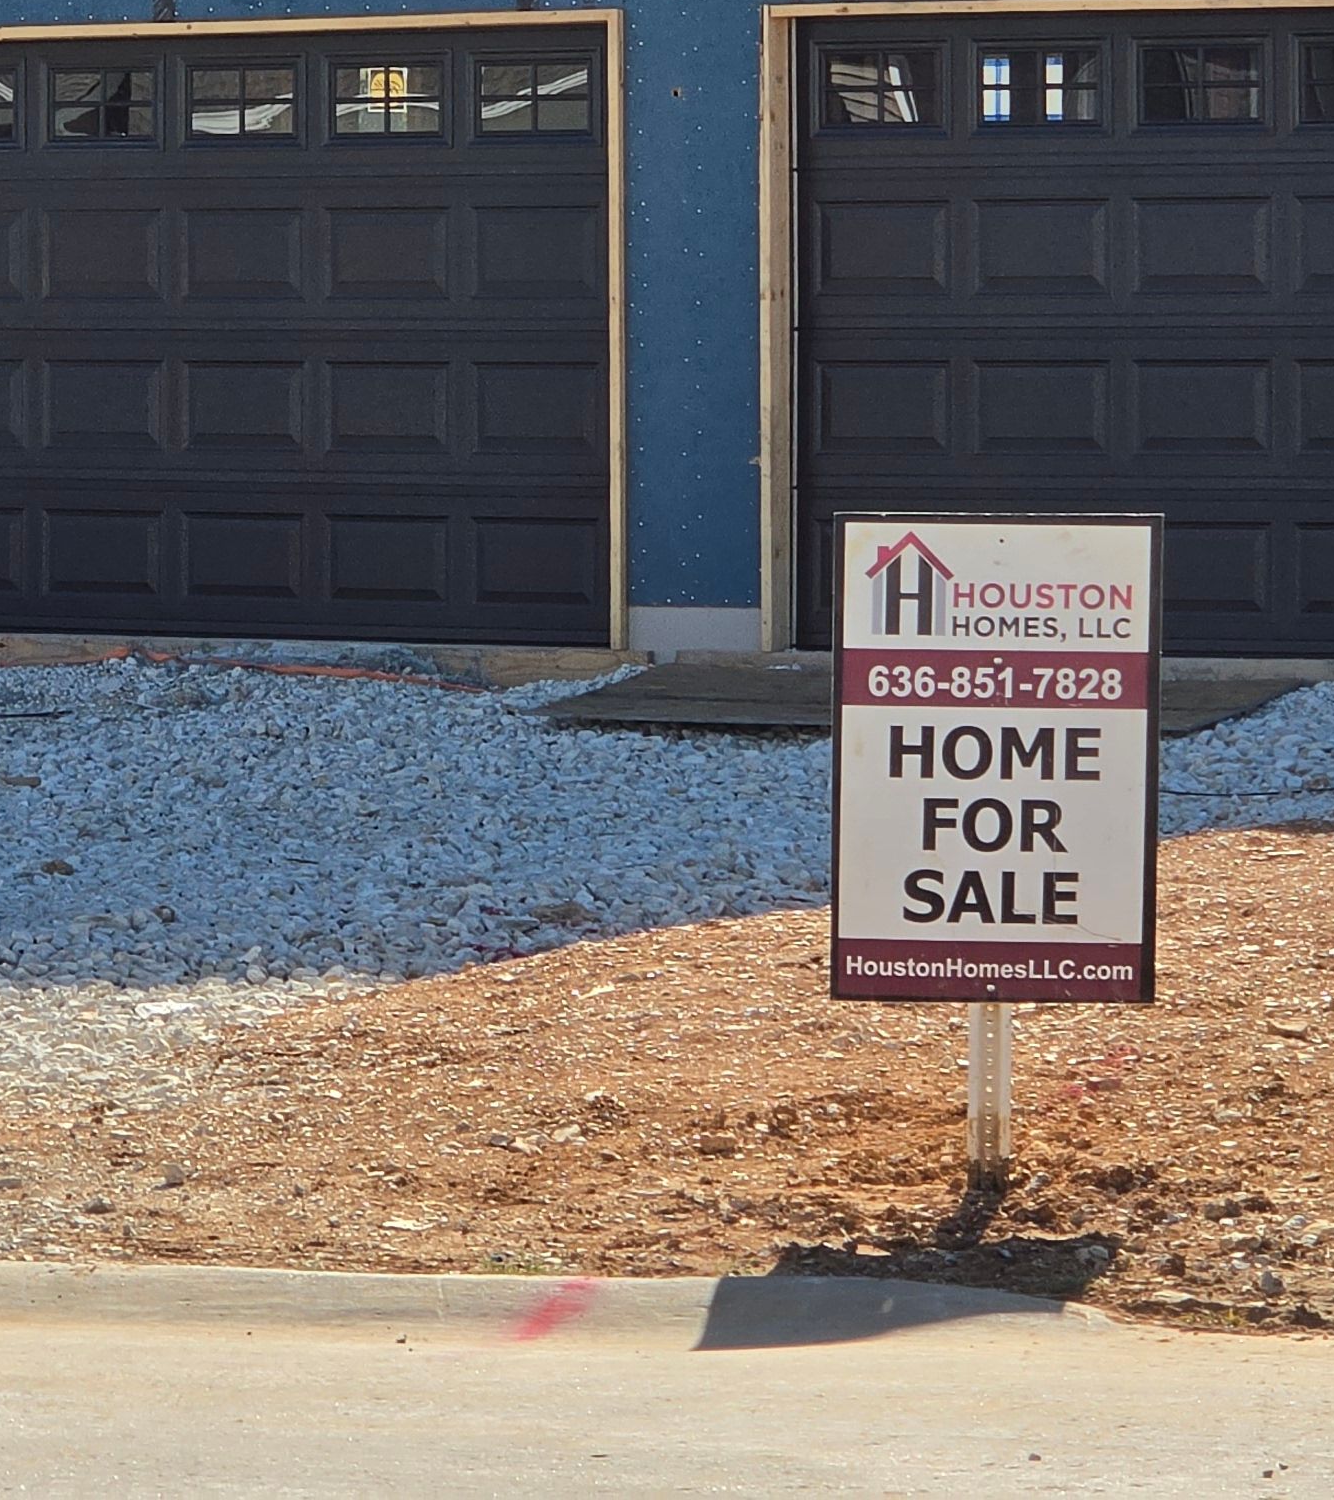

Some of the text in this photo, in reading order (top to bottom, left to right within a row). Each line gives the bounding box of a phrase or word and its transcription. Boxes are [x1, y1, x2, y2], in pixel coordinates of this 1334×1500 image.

[952, 582, 1133, 611] HOUSTON
[951, 616, 1132, 643] HOMES, LLC
[868, 664, 1123, 700] 636-851-7828
[888, 724, 1102, 781] HOME
[921, 797, 1068, 853] FOR
[902, 868, 1080, 925] SALE
[846, 955, 1133, 981] HoustonHomesLLC.com
